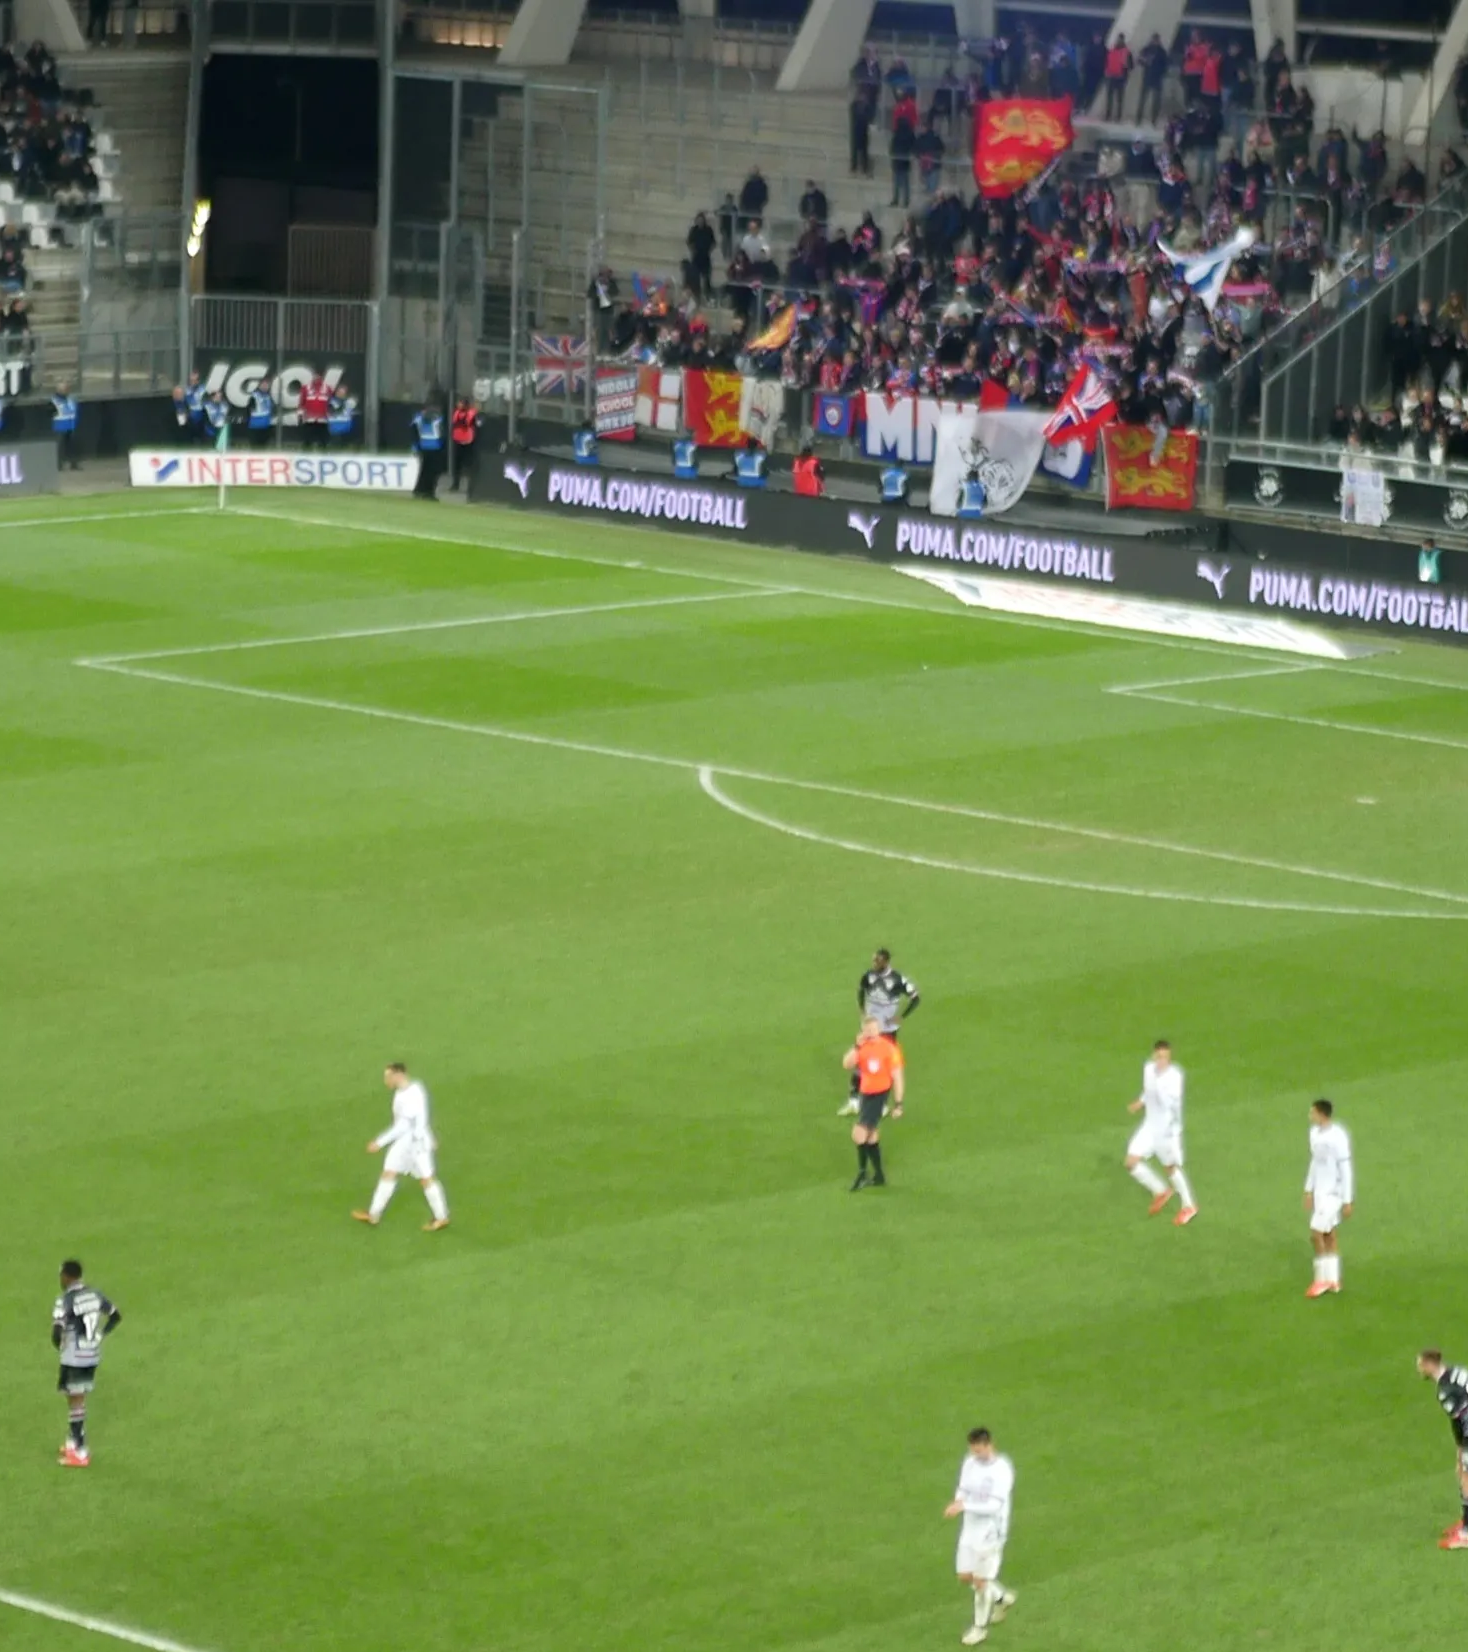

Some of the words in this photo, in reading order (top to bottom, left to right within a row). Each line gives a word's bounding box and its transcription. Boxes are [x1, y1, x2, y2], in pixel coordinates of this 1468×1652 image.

[187, 457, 408, 487] INTERSPORT
[548, 471, 748, 529] PUMA.COM/FOOTBALL
[895, 520, 1115, 582] PUMA.COM/FOOTBALL
